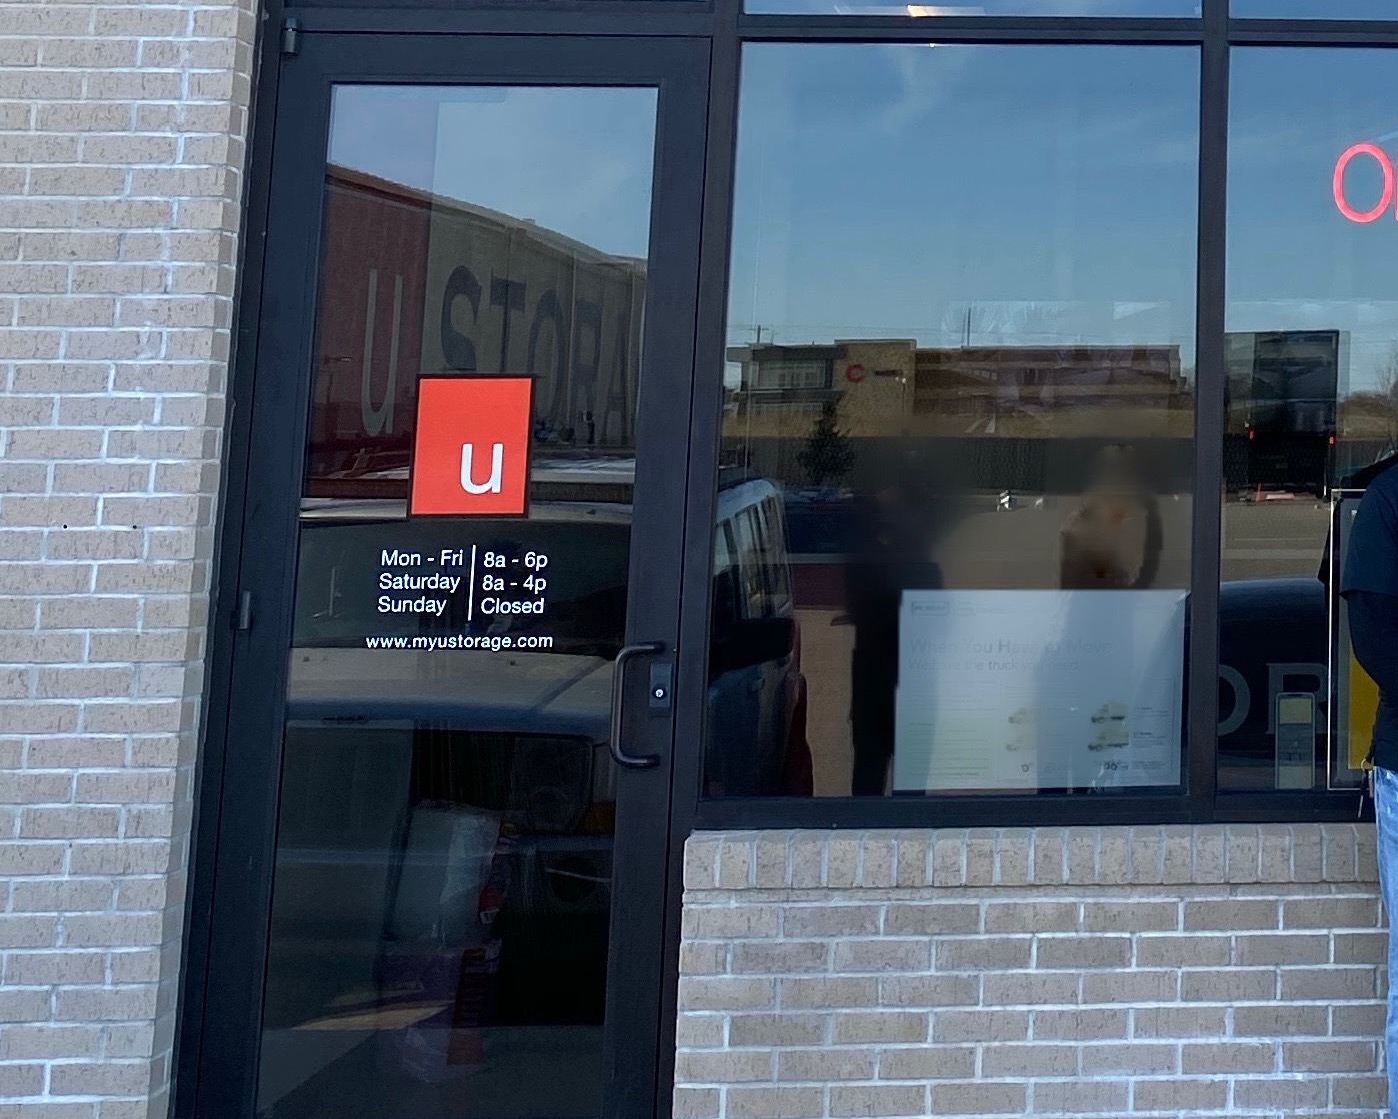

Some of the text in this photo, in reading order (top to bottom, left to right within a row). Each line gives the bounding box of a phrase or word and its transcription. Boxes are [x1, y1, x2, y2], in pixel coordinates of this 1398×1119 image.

[460, 443, 504, 495] u
[381, 549, 421, 567] Mon
[440, 549, 464, 567] Fri
[483, 551, 506, 568] 8a
[524, 551, 548, 571] 6p
[379, 572, 461, 594] Saturday
[482, 574, 505, 591] 8a
[523, 574, 547, 594] 4p
[378, 596, 545, 616] Sunday Closed
[366, 634, 554, 652] www.myustorage.com
[963, 639, 993, 654] You
[998, 639, 1040, 654] Have
[988, 659, 1017, 671] truck
